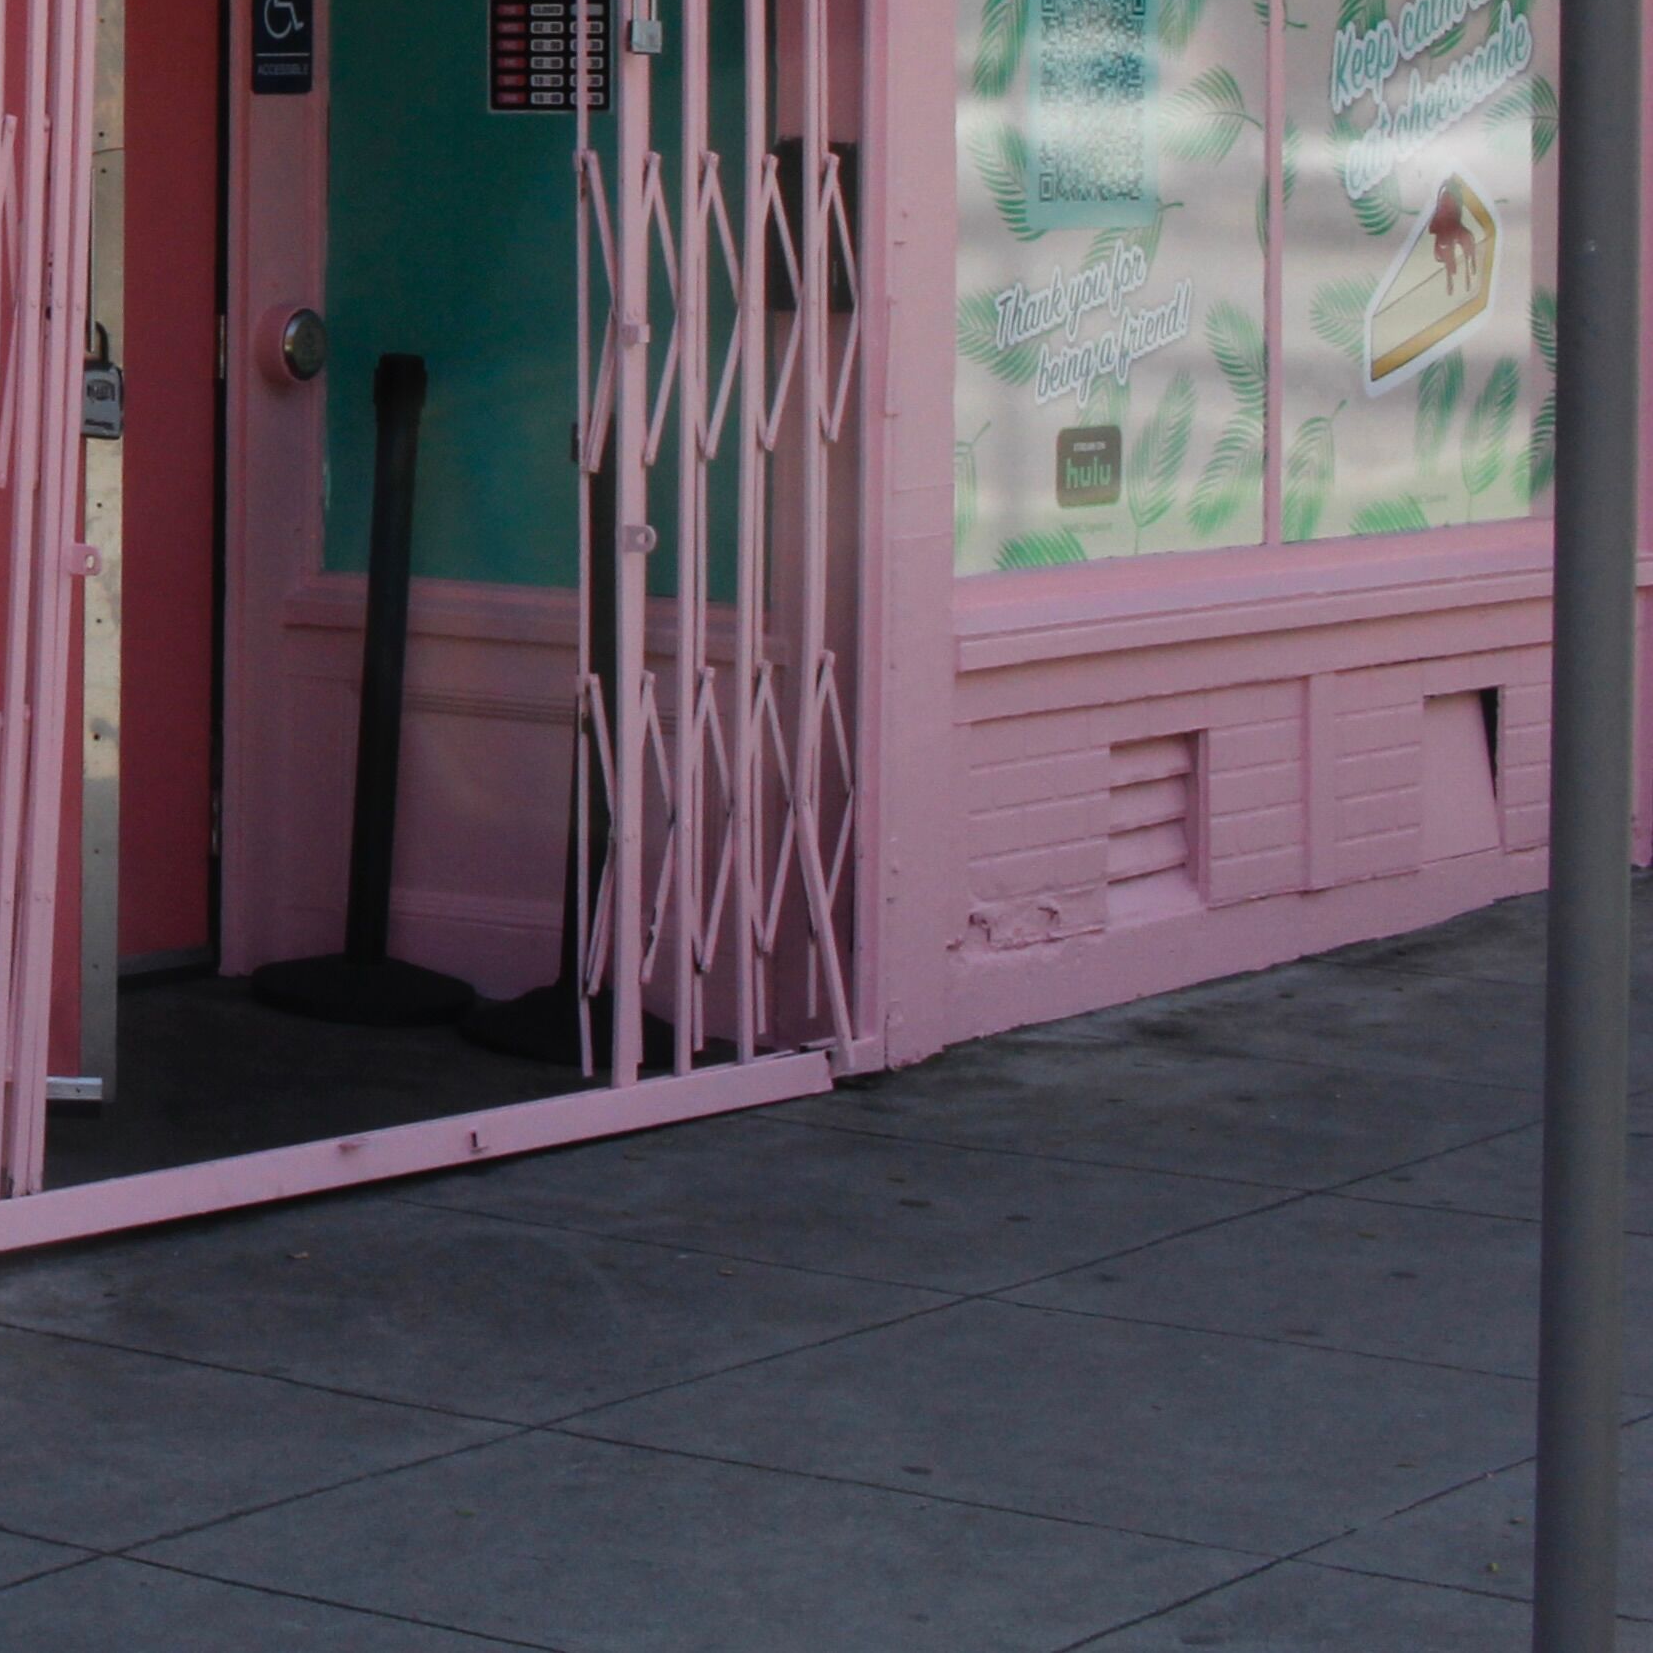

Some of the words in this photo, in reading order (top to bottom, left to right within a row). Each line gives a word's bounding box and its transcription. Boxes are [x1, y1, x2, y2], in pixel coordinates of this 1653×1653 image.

[1334, 30, 1394, 107] Keep
[1397, 6, 1528, 153] cheesecake
[998, 270, 1062, 343] Thank
[1070, 269, 1107, 337] you
[1112, 242, 1144, 314] for
[1039, 346, 1093, 403] being
[1100, 337, 1114, 368] a
[1118, 281, 1190, 380] friend!
[1067, 456, 1111, 489] hulu
